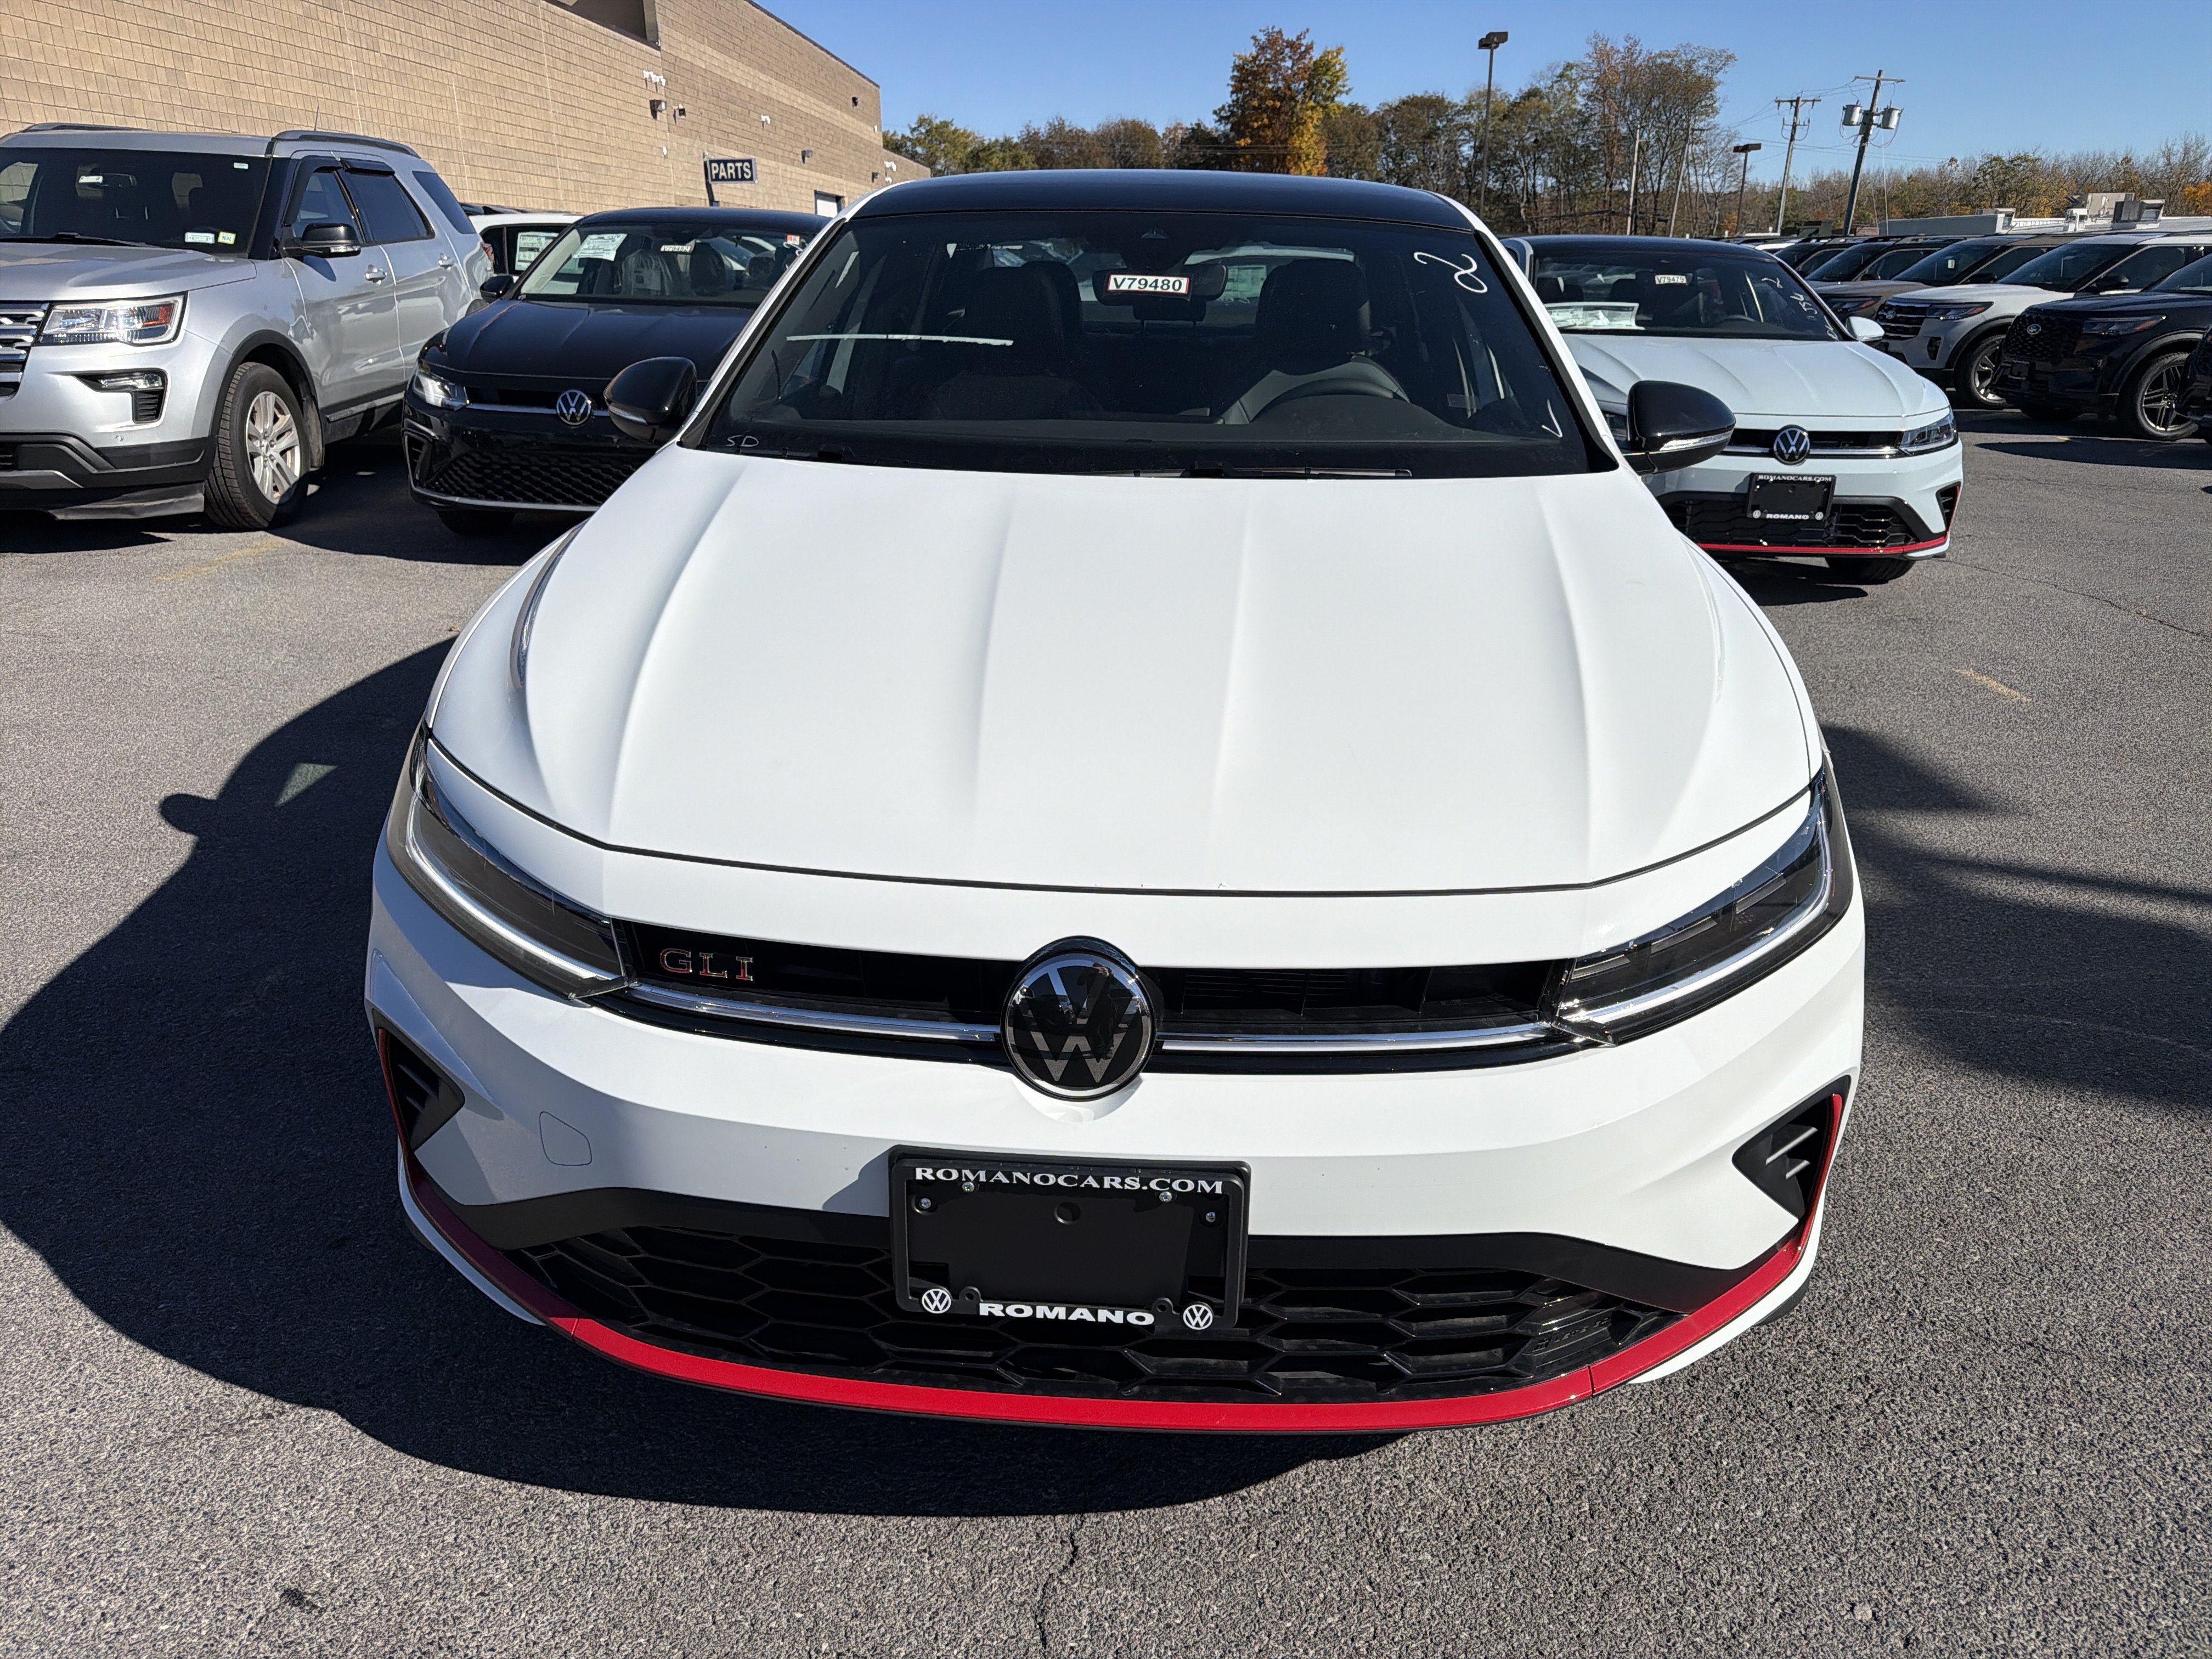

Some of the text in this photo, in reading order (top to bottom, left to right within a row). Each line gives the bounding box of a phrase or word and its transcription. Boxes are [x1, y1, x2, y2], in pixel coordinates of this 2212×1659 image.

[711, 161, 752, 179] PARTS
[1113, 277, 1183, 291] V79480
[556, 389, 591, 425] VW
[1774, 427, 1810, 464] VW
[660, 948, 753, 981] GLI
[1006, 953, 1150, 1096] VW
[915, 1166, 1223, 1195] ROMANOCARS.COM
[922, 1288, 952, 1314] VW
[979, 1302, 1155, 1326] ROMANO
[1183, 1304, 1214, 1330] VW
